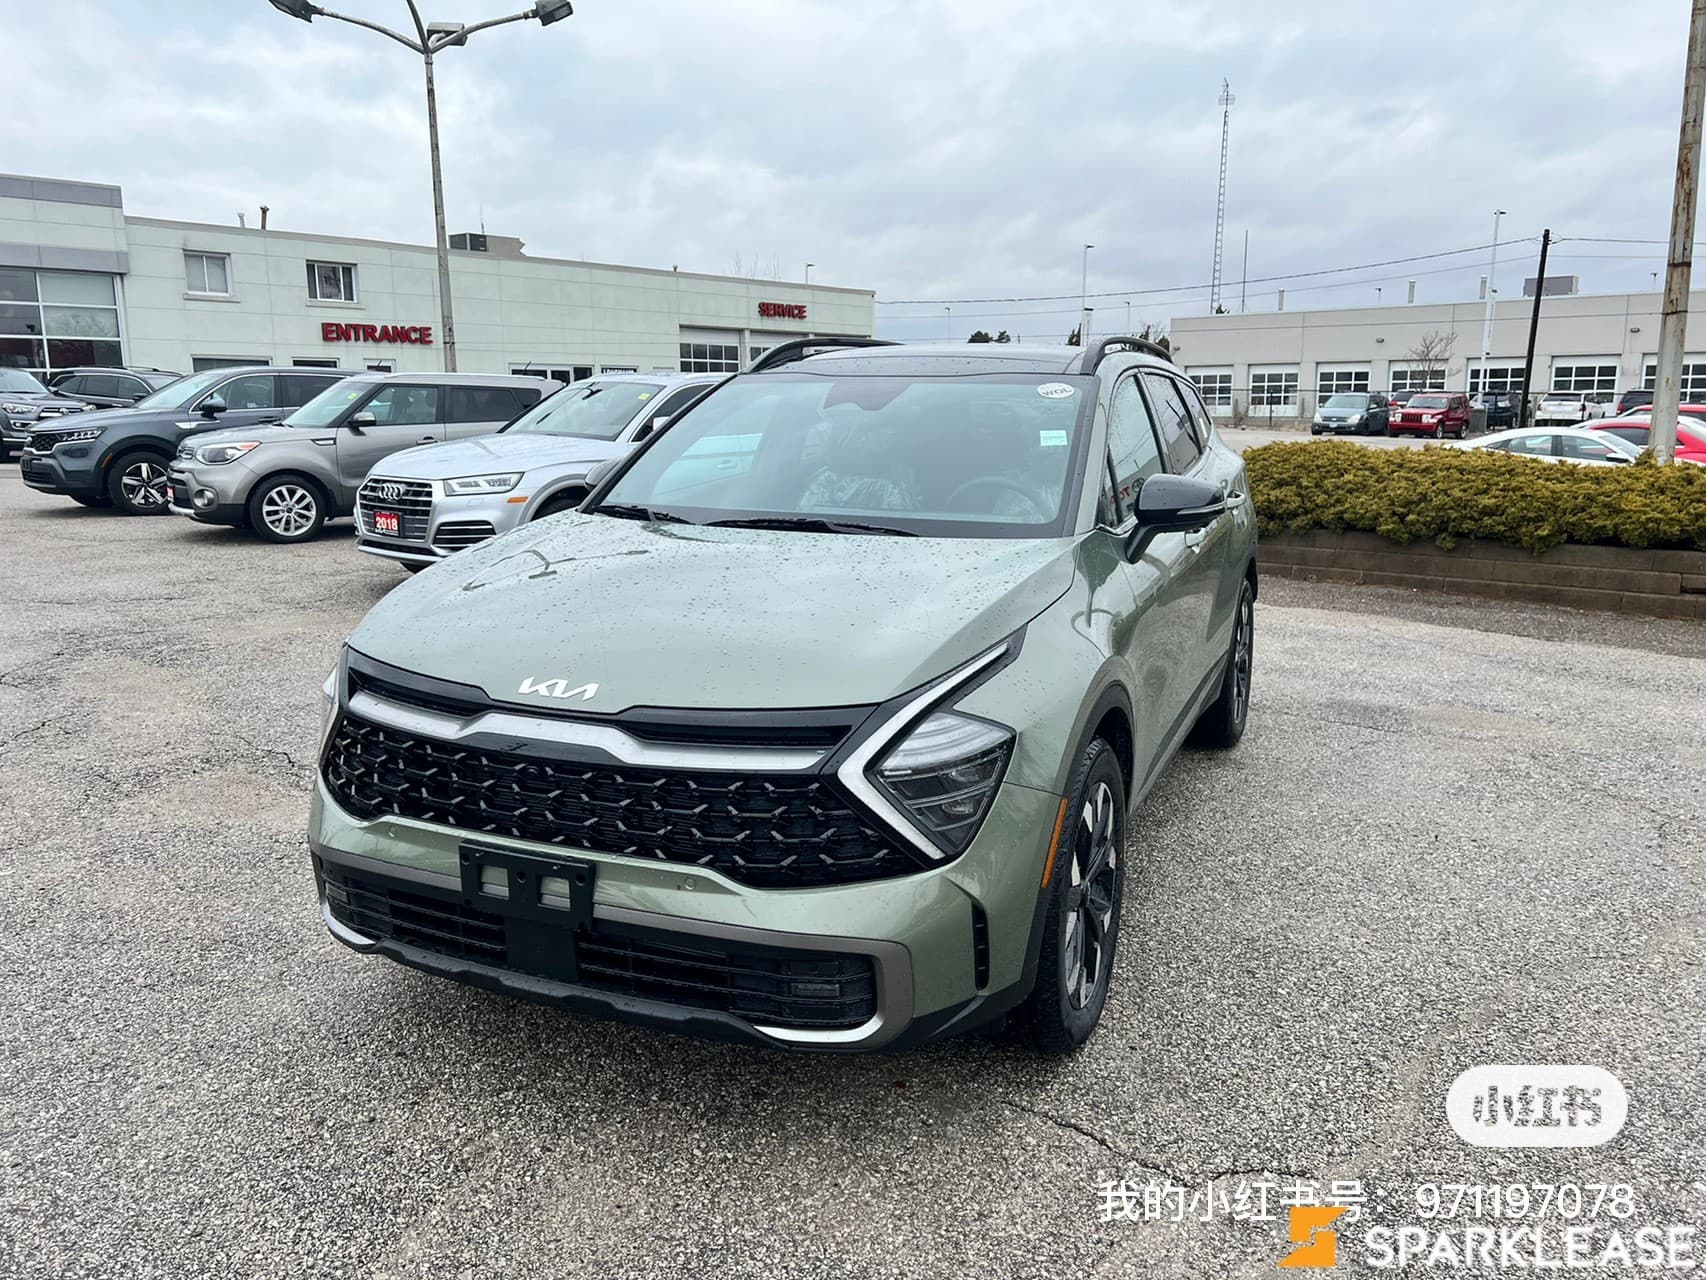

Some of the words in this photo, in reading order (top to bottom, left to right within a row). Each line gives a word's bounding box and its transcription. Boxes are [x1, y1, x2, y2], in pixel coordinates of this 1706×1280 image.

[758, 302, 807, 320] SERVICE
[321, 322, 434, 345] ENTRANCE
[375, 516, 398, 531] 2018
